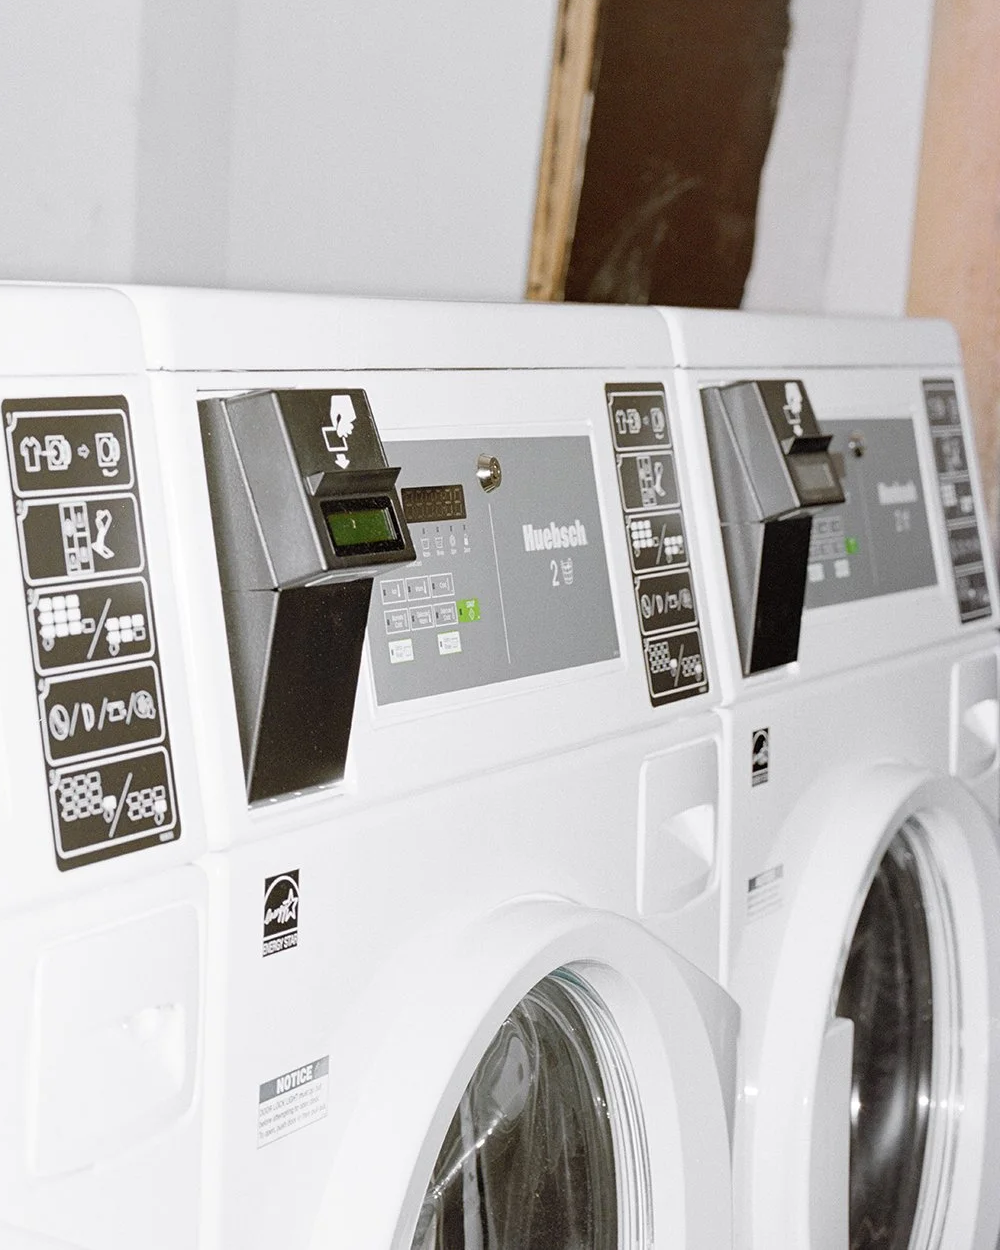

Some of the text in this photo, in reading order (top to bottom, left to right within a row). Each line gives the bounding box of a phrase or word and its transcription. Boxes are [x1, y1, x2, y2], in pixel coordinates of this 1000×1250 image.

[522, 519, 587, 551] Huebsch
[550, 560, 560, 587] 2
[276, 1064, 313, 1094] NOTICE
